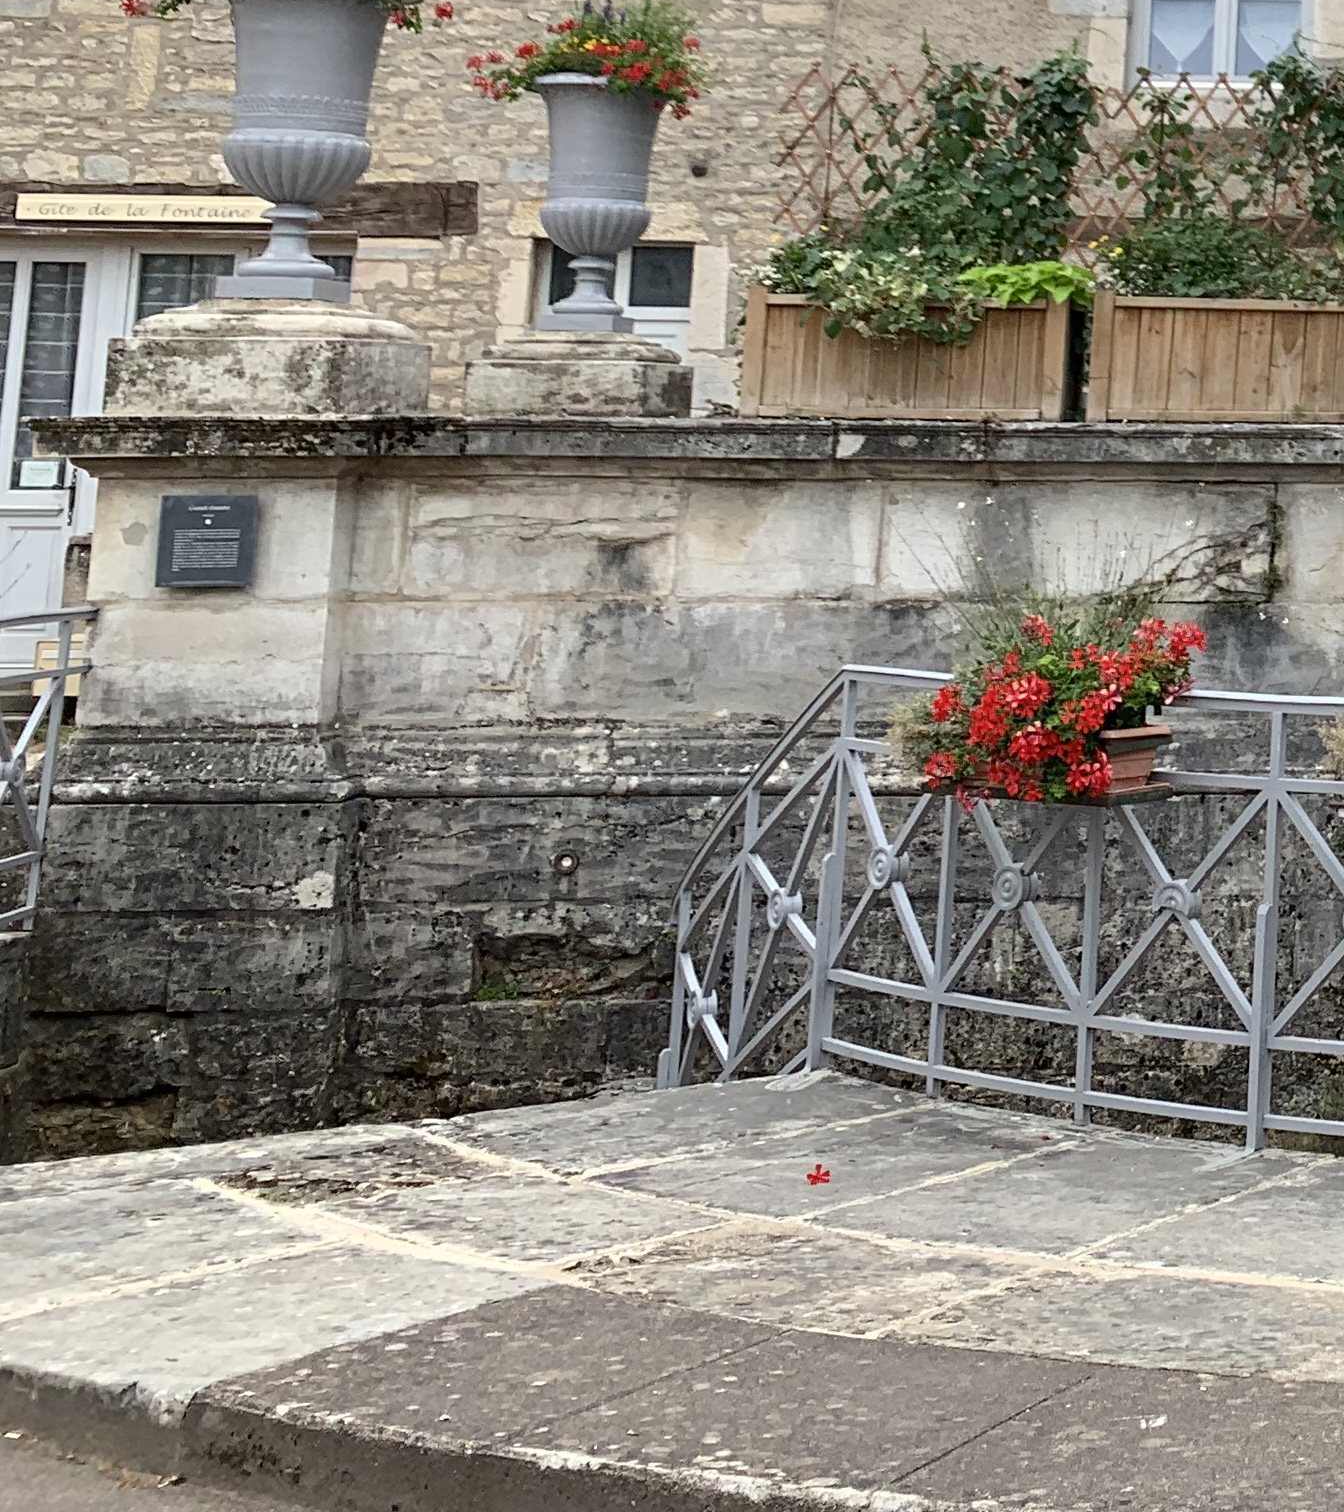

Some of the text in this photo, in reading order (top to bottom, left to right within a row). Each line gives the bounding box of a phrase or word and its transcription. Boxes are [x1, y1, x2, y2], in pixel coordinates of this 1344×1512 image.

[88, 202, 114, 216] de
[126, 203, 148, 217] la
[160, 204, 253, 219] Fontaine
